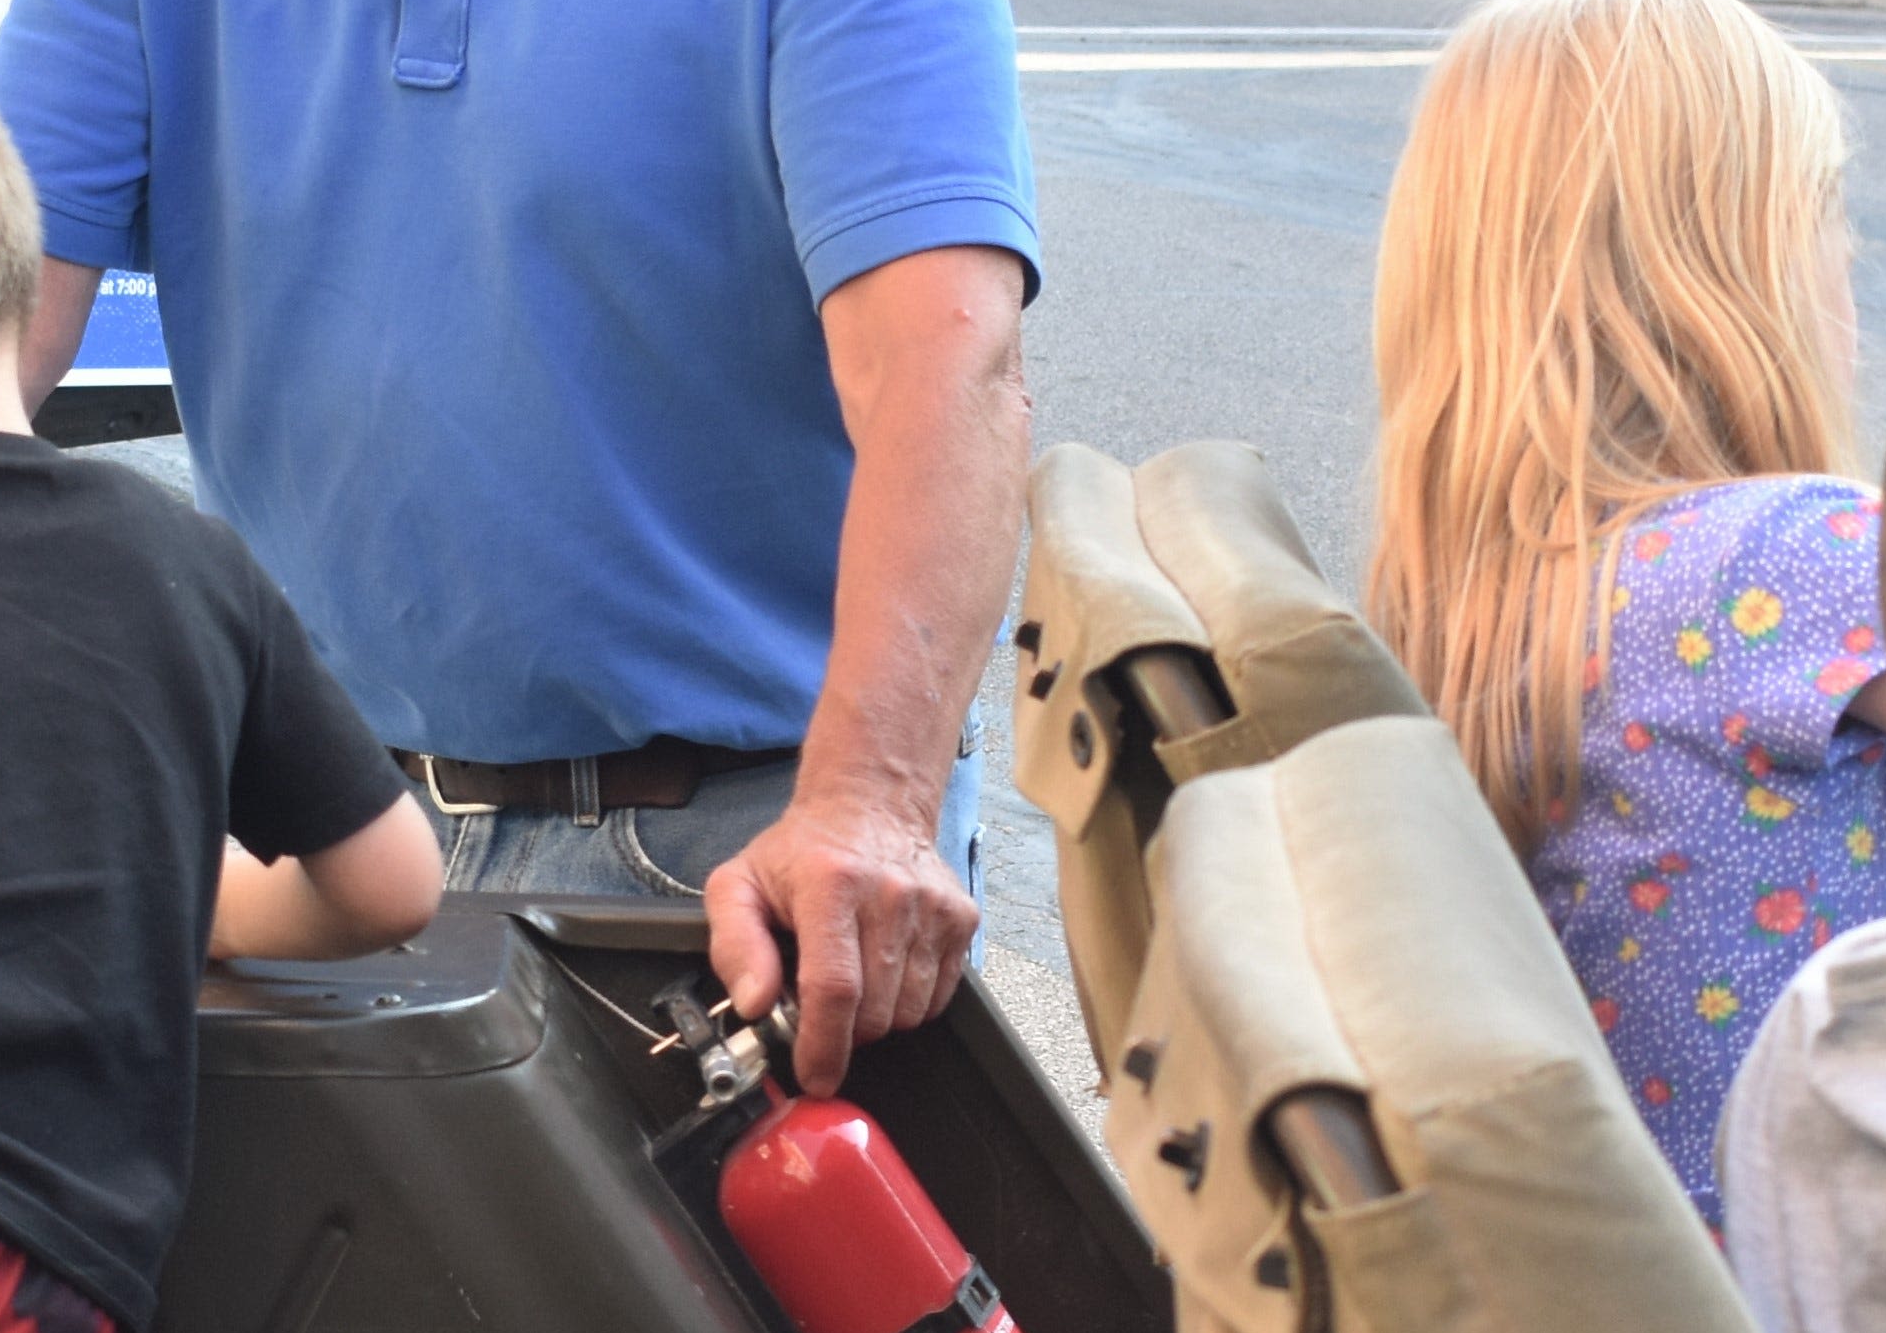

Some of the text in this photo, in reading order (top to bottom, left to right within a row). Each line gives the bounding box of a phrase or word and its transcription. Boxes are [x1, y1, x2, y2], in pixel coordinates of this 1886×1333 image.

[100, 278, 157, 298] at 7:00 p
